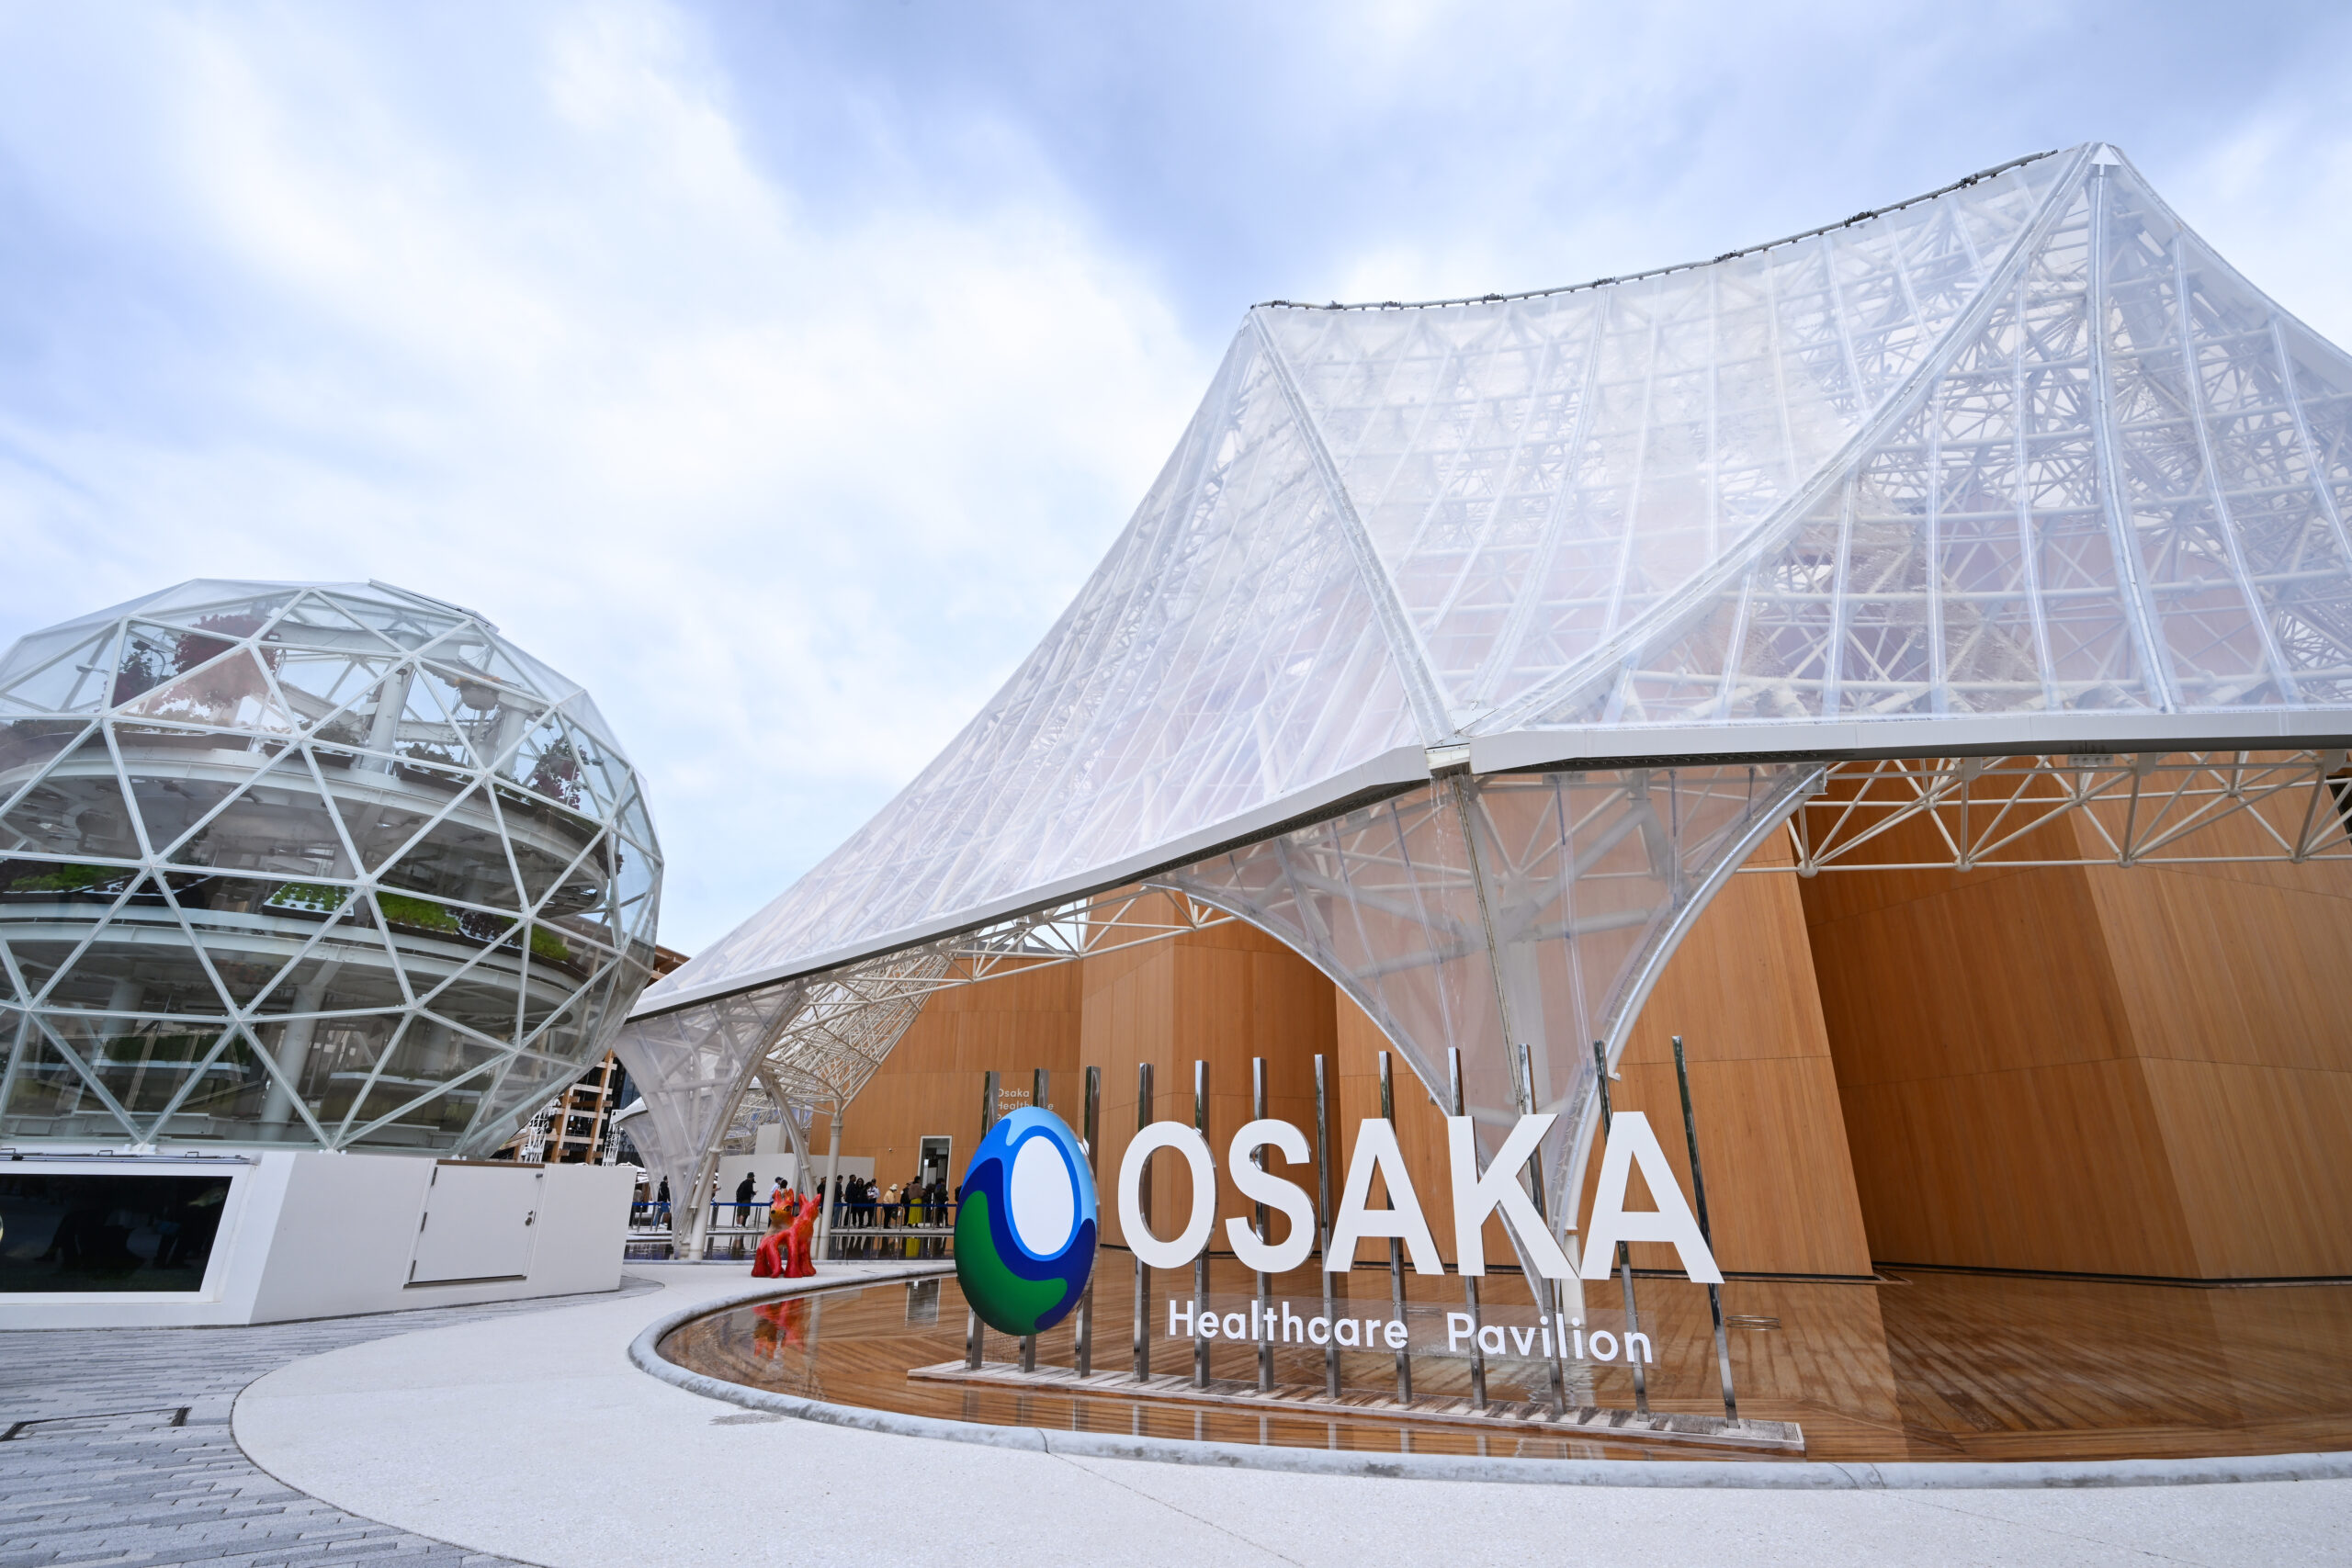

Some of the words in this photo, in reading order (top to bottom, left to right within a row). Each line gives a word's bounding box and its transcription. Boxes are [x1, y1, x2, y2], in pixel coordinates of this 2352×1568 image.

[999, 1088, 1030, 1098] Osaka
[1117, 1111, 1725, 1284] OSAKA
[1169, 1300, 1408, 1349] Healthcare
[1446, 1312, 1653, 1363] Pavilion
